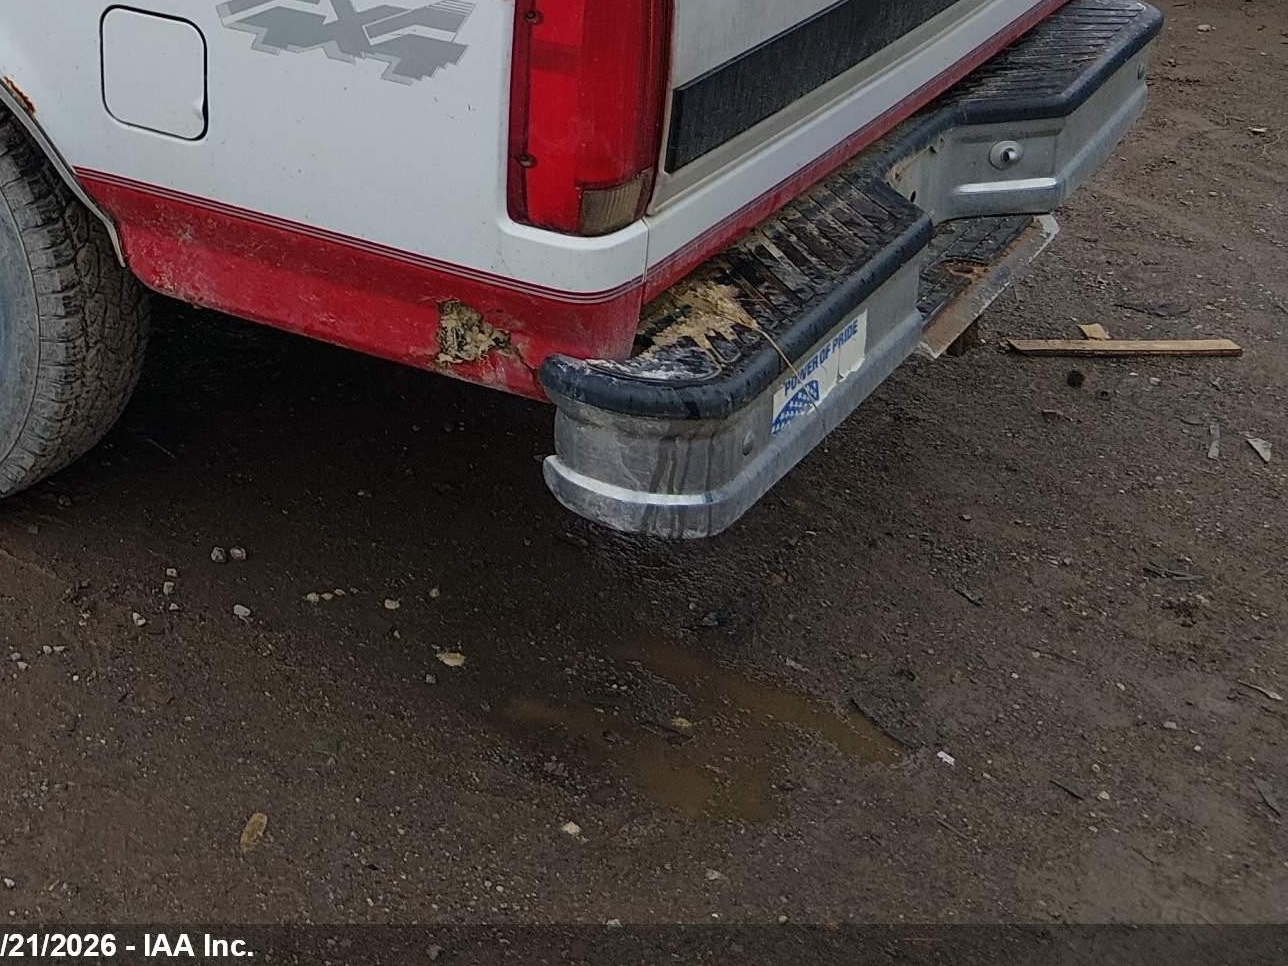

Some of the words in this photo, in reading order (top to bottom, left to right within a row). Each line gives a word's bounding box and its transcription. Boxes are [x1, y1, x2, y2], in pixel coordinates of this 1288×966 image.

[785, 357, 819, 395] POWER
[819, 345, 832, 363] OF
[833, 320, 858, 353] PRIDE
